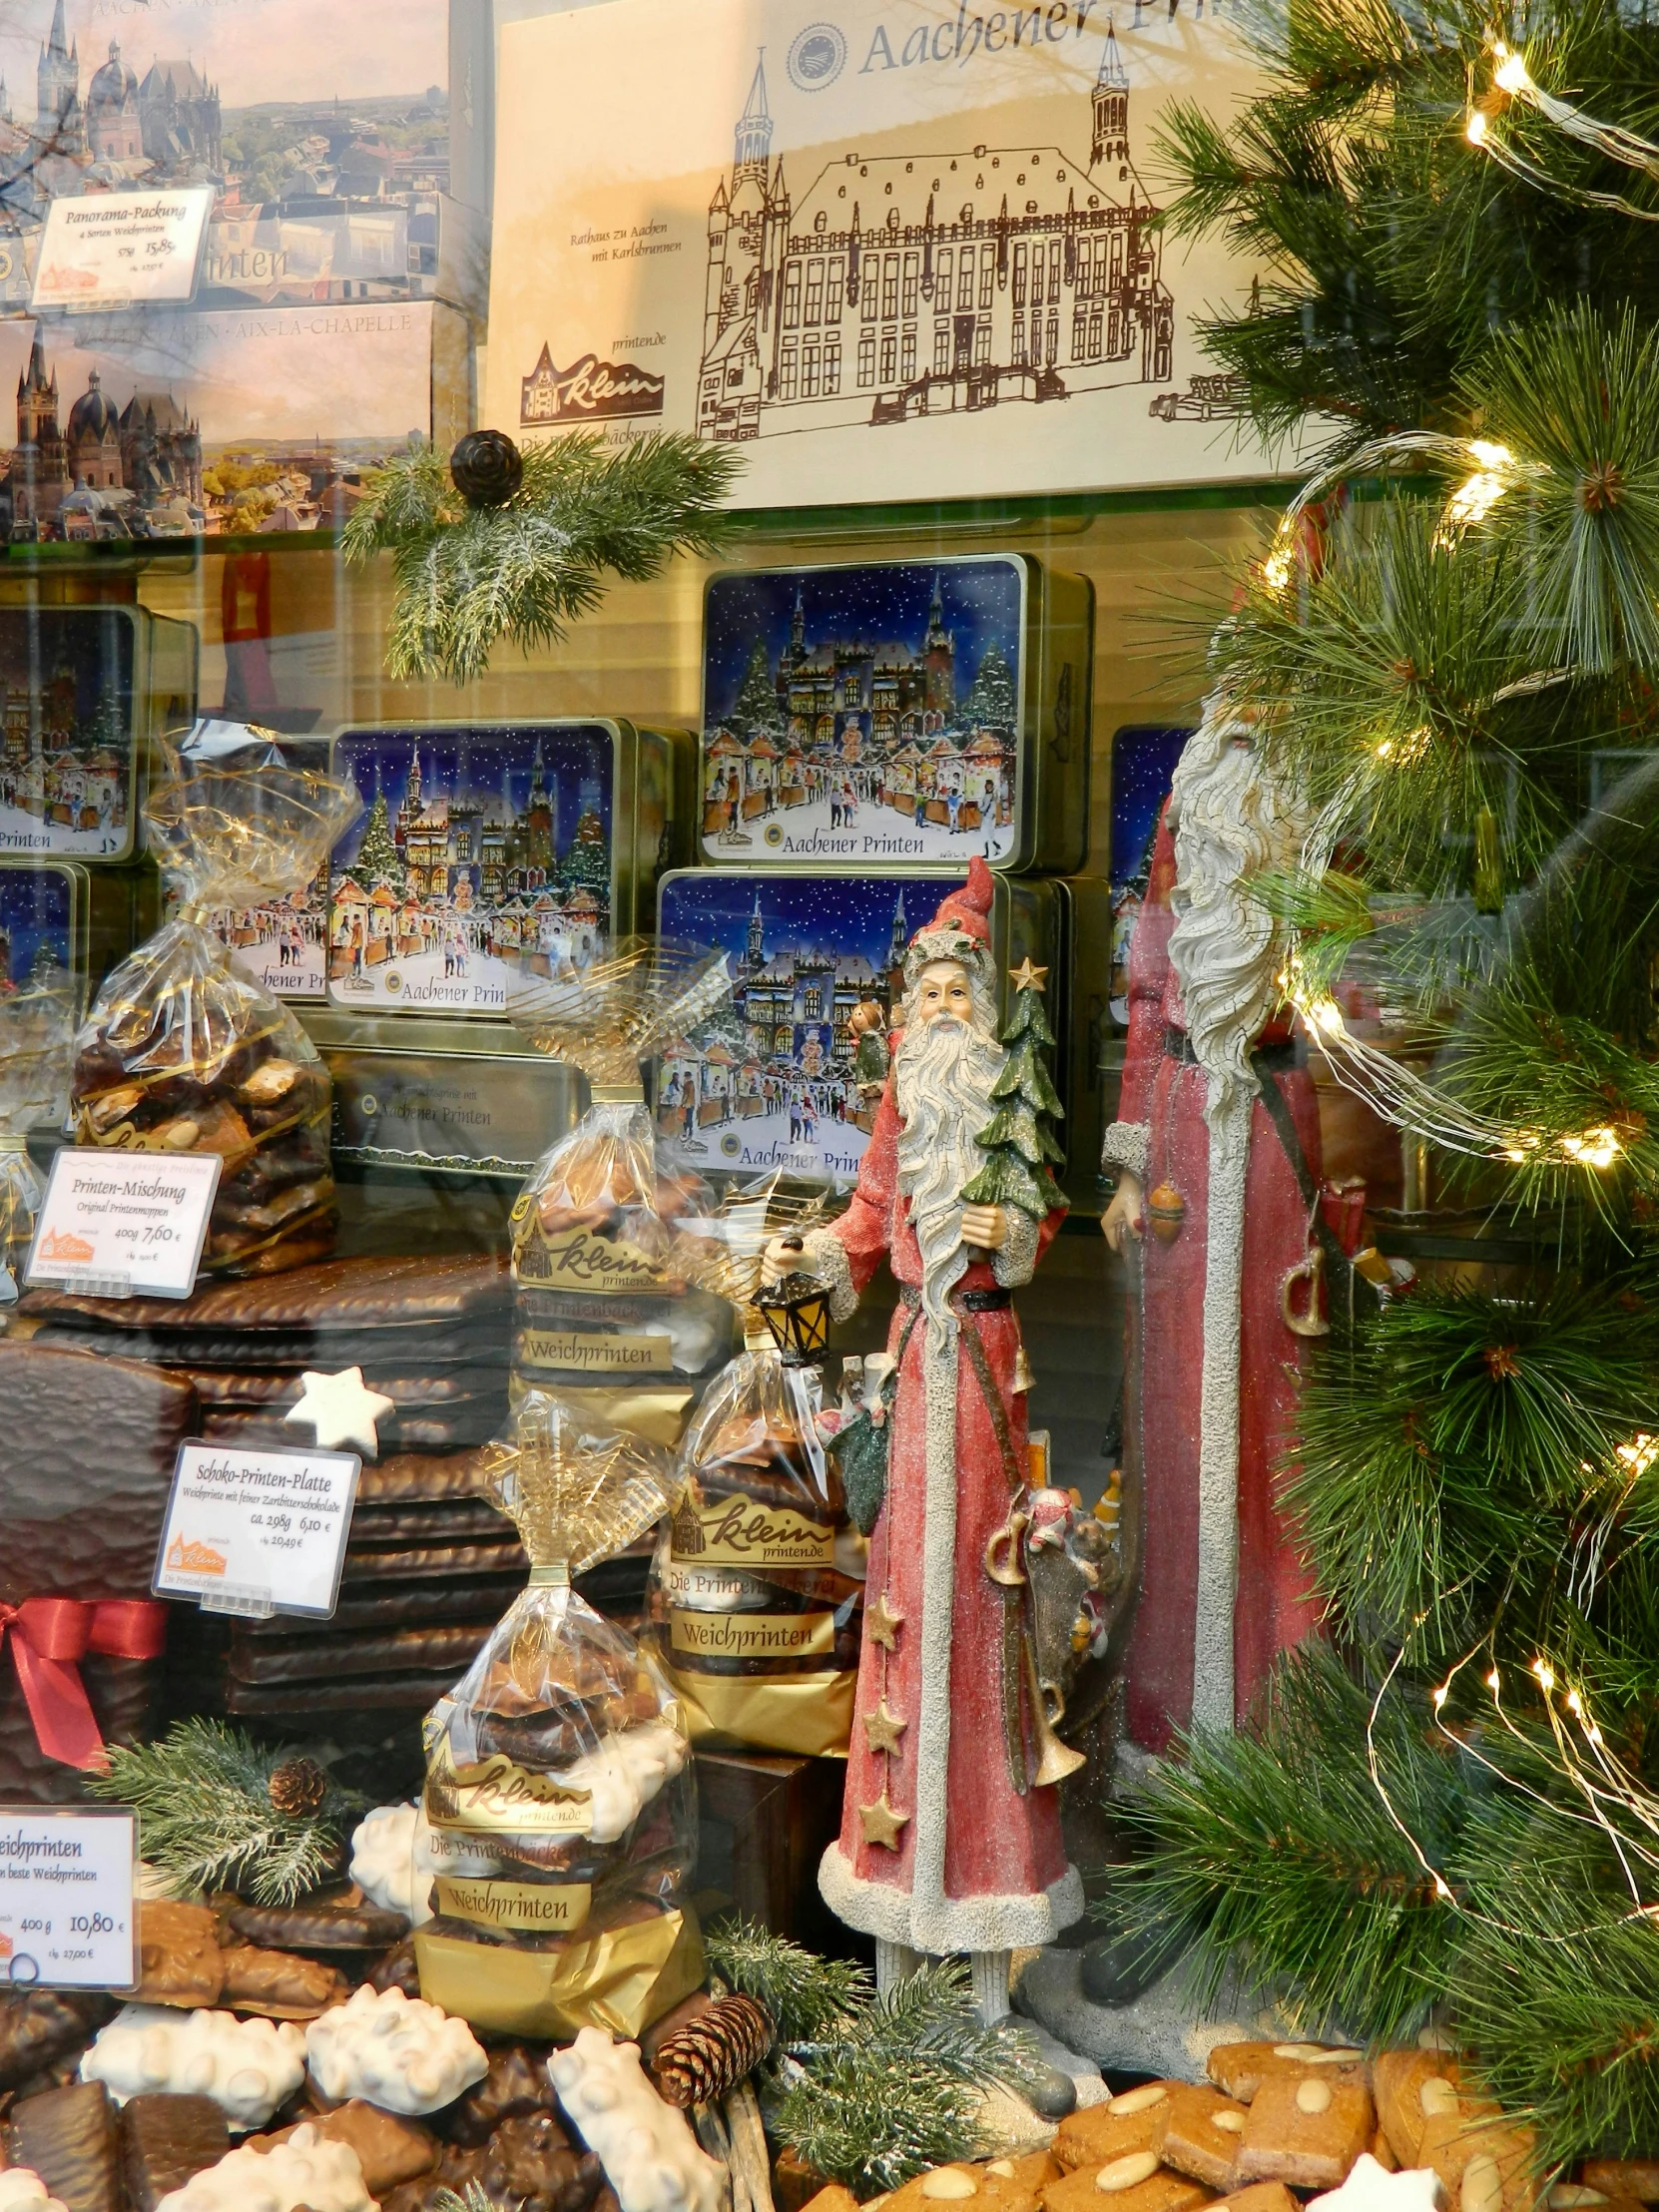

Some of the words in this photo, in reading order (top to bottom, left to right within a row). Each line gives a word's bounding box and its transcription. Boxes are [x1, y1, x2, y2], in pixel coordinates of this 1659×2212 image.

[857, 0, 1097, 75] Aachener
[66, 201, 187, 225] Panorama-Packung
[87, 228, 111, 239] Sorten
[115, 224, 165, 237] Weichprinten
[570, 228, 611, 247] Rathaus
[613, 230, 627, 241] zu
[630, 219, 668, 239] Aachen
[592, 249, 608, 263] mit
[612, 241, 682, 260] Karlsbrunnen
[235, 314, 411, 339] AIX-LA-CHAPELLE
[612, 332, 667, 354] printen.de
[783, 828, 857, 856] Aachener
[862, 835, 924, 853] Printen
[401, 976, 469, 1003] Aachener
[473, 984, 504, 1003] Prin
[442, 1105, 491, 1125] Printen
[739, 1141, 818, 1170] Aachener
[824, 1151, 861, 1172] Prin
[72, 1177, 186, 1204] Printen-Mischung
[77, 1199, 109, 1212] Original
[110, 1203, 169, 1217] Printenmoppen
[115, 1229, 139, 1241] 400g
[142, 1225, 173, 1245] 7,60
[550, 1233, 664, 1279] klein
[602, 1274, 658, 1288] printen.de
[530, 1335, 653, 1369] Weichprinten
[197, 1459, 331, 1492] Schoko-Printen-Platte
[183, 1484, 224, 1501] Weichprinte
[226, 1491, 238, 1501] mit
[239, 1489, 261, 1504] feiner
[263, 1493, 340, 1513] Zartbitterschokolade
[267, 1513, 291, 1531] 298g
[299, 1516, 321, 1534] 6,10
[701, 1502, 831, 1551] klein
[272, 1536, 296, 1549] 20,49
[763, 1544, 824, 1560] printen.de
[670, 1571, 691, 1592] Die
[683, 1617, 814, 1654] Weichprinten
[457, 1765, 591, 1815] klein
[519, 1808, 581, 1825] printen.de
[0, 1830, 82, 1863] eichprinten
[430, 1835, 452, 1856] Die
[9, 1863, 30, 1880] beste
[33, 1864, 97, 1885] Weichprinten
[449, 1884, 568, 1923] Weichprinten
[21, 1919, 43, 1933] 400
[70, 1913, 114, 1939] 10,80
[119, 1923, 125, 1933] €
